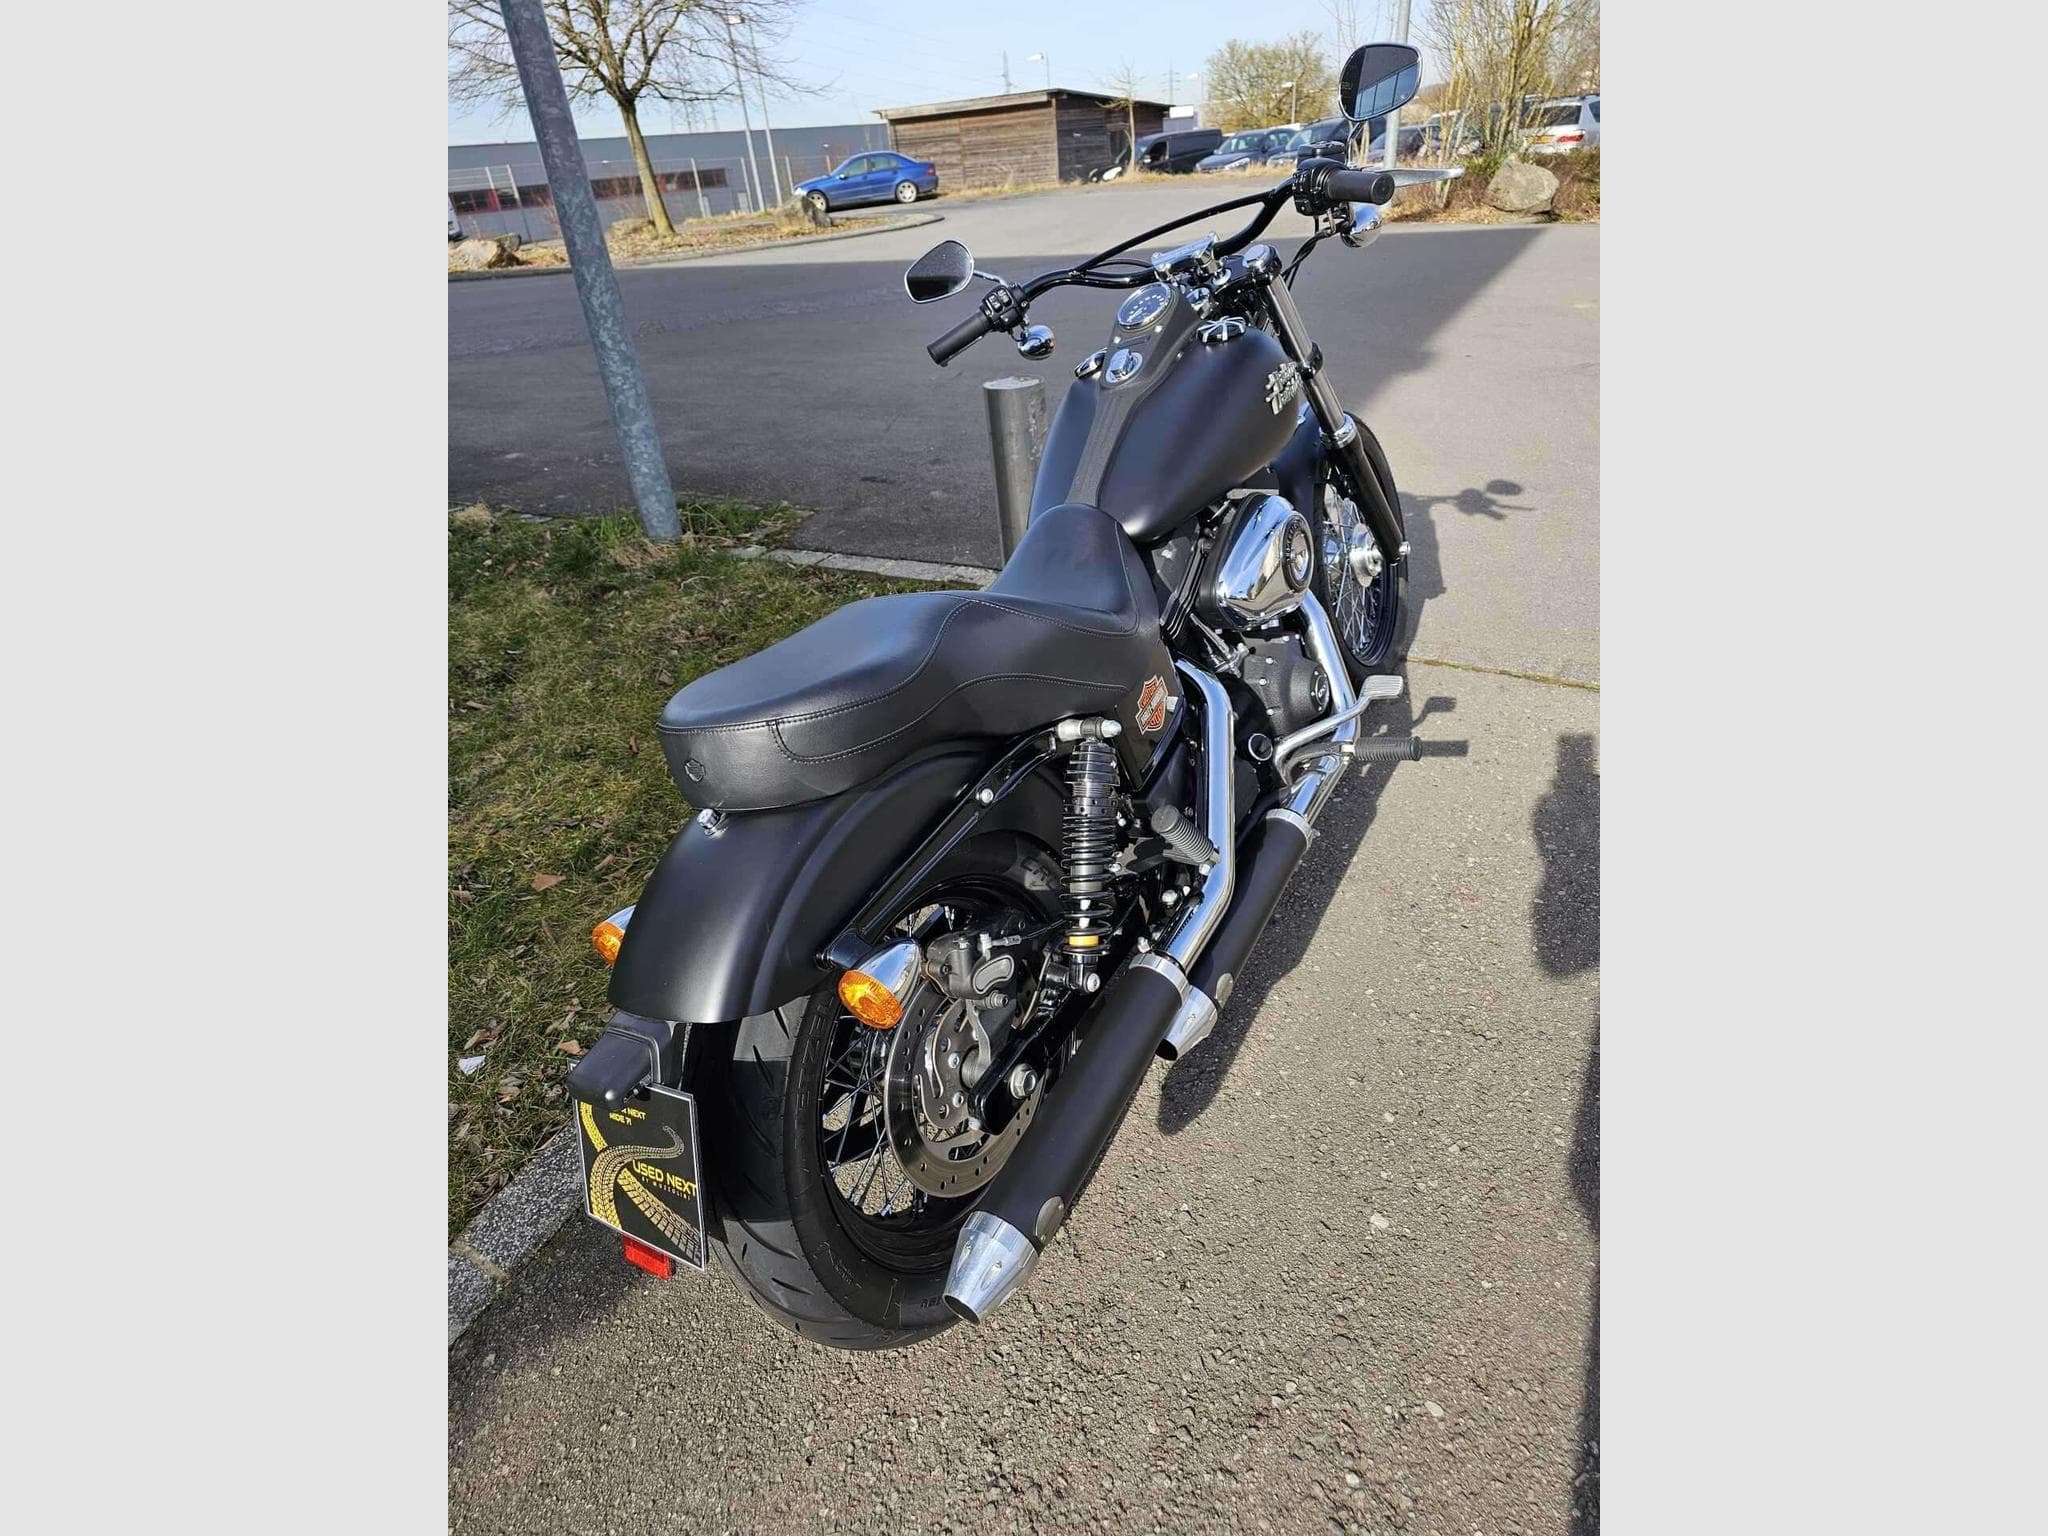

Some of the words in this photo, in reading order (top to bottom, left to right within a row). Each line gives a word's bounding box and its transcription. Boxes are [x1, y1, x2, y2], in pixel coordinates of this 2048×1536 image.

[627, 1107, 647, 1120] NEXT
[633, 1159, 664, 1182] USED
[666, 1172, 697, 1197] NEXT
